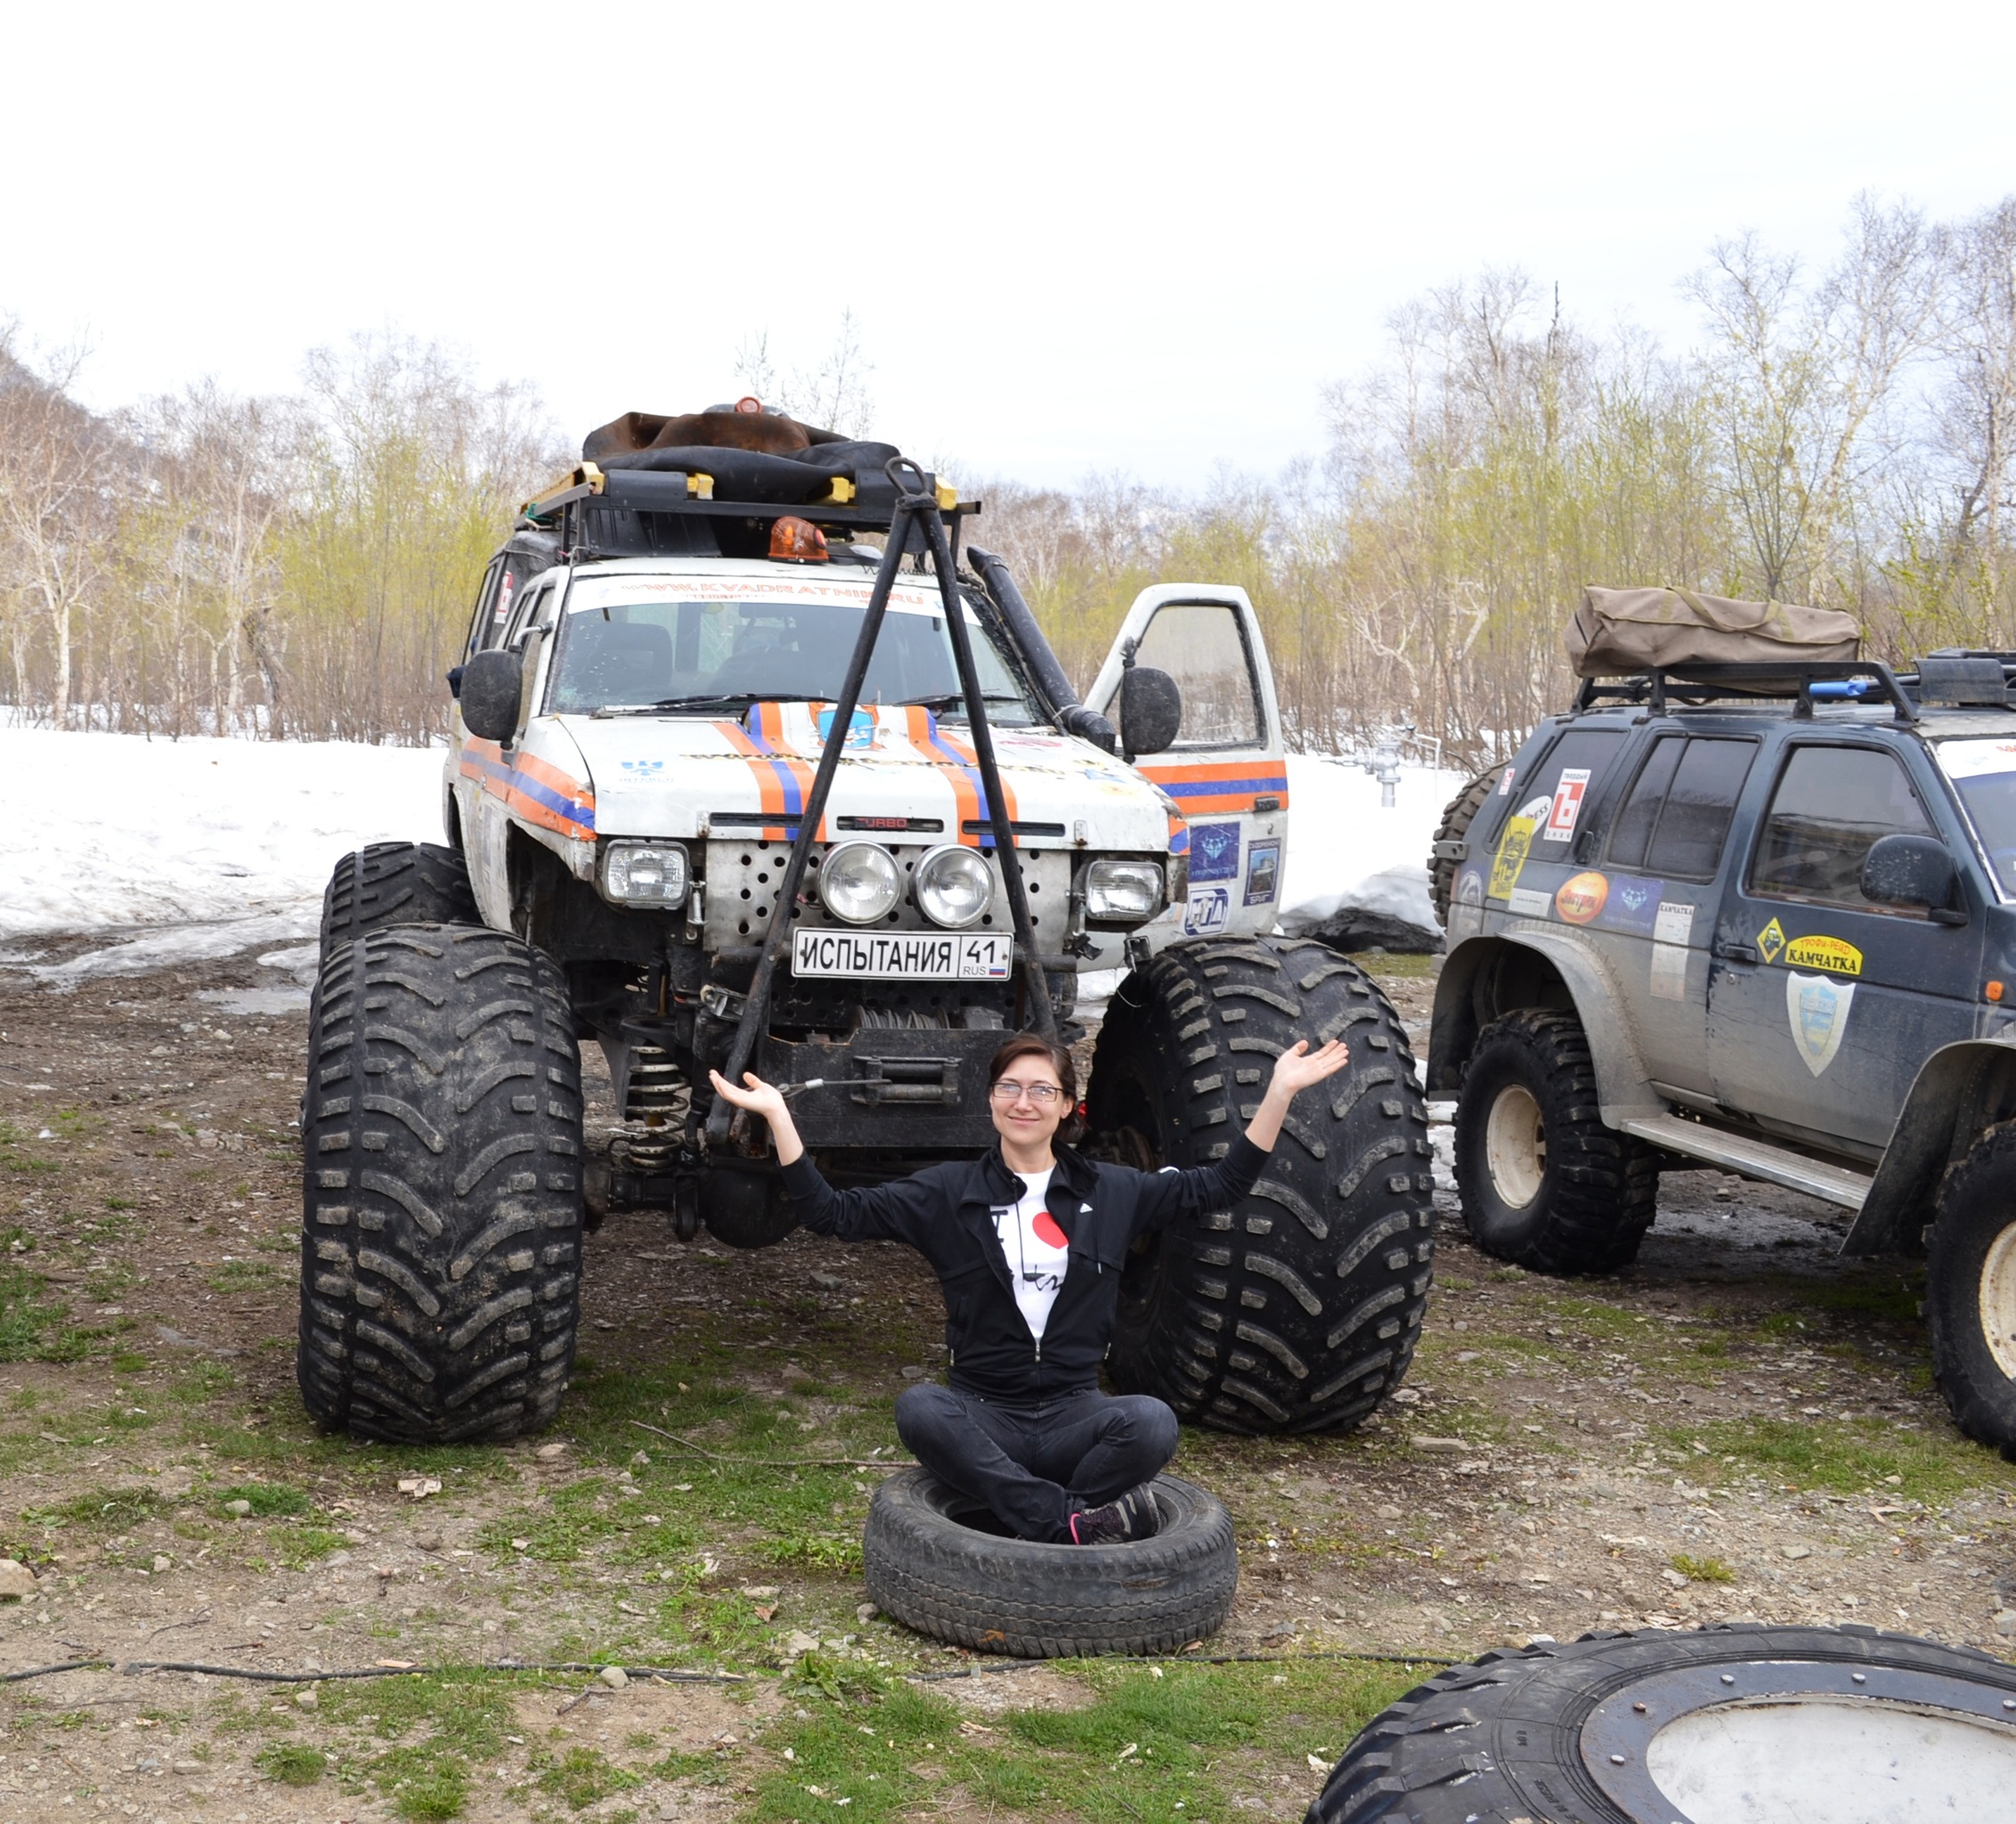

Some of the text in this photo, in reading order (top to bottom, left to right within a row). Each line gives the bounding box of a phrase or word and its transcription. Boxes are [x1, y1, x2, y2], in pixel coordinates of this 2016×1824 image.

[622, 583, 924, 606] WWW.KVADRATNIKRU
[1659, 903, 1693, 916] КАМЧАТКА
[802, 936, 952, 973] ИСПЫТАНИЯ
[966, 940, 997, 965] 41
[1788, 949, 1857, 972] КАМЧАТКА
[963, 965, 987, 976] RUS
